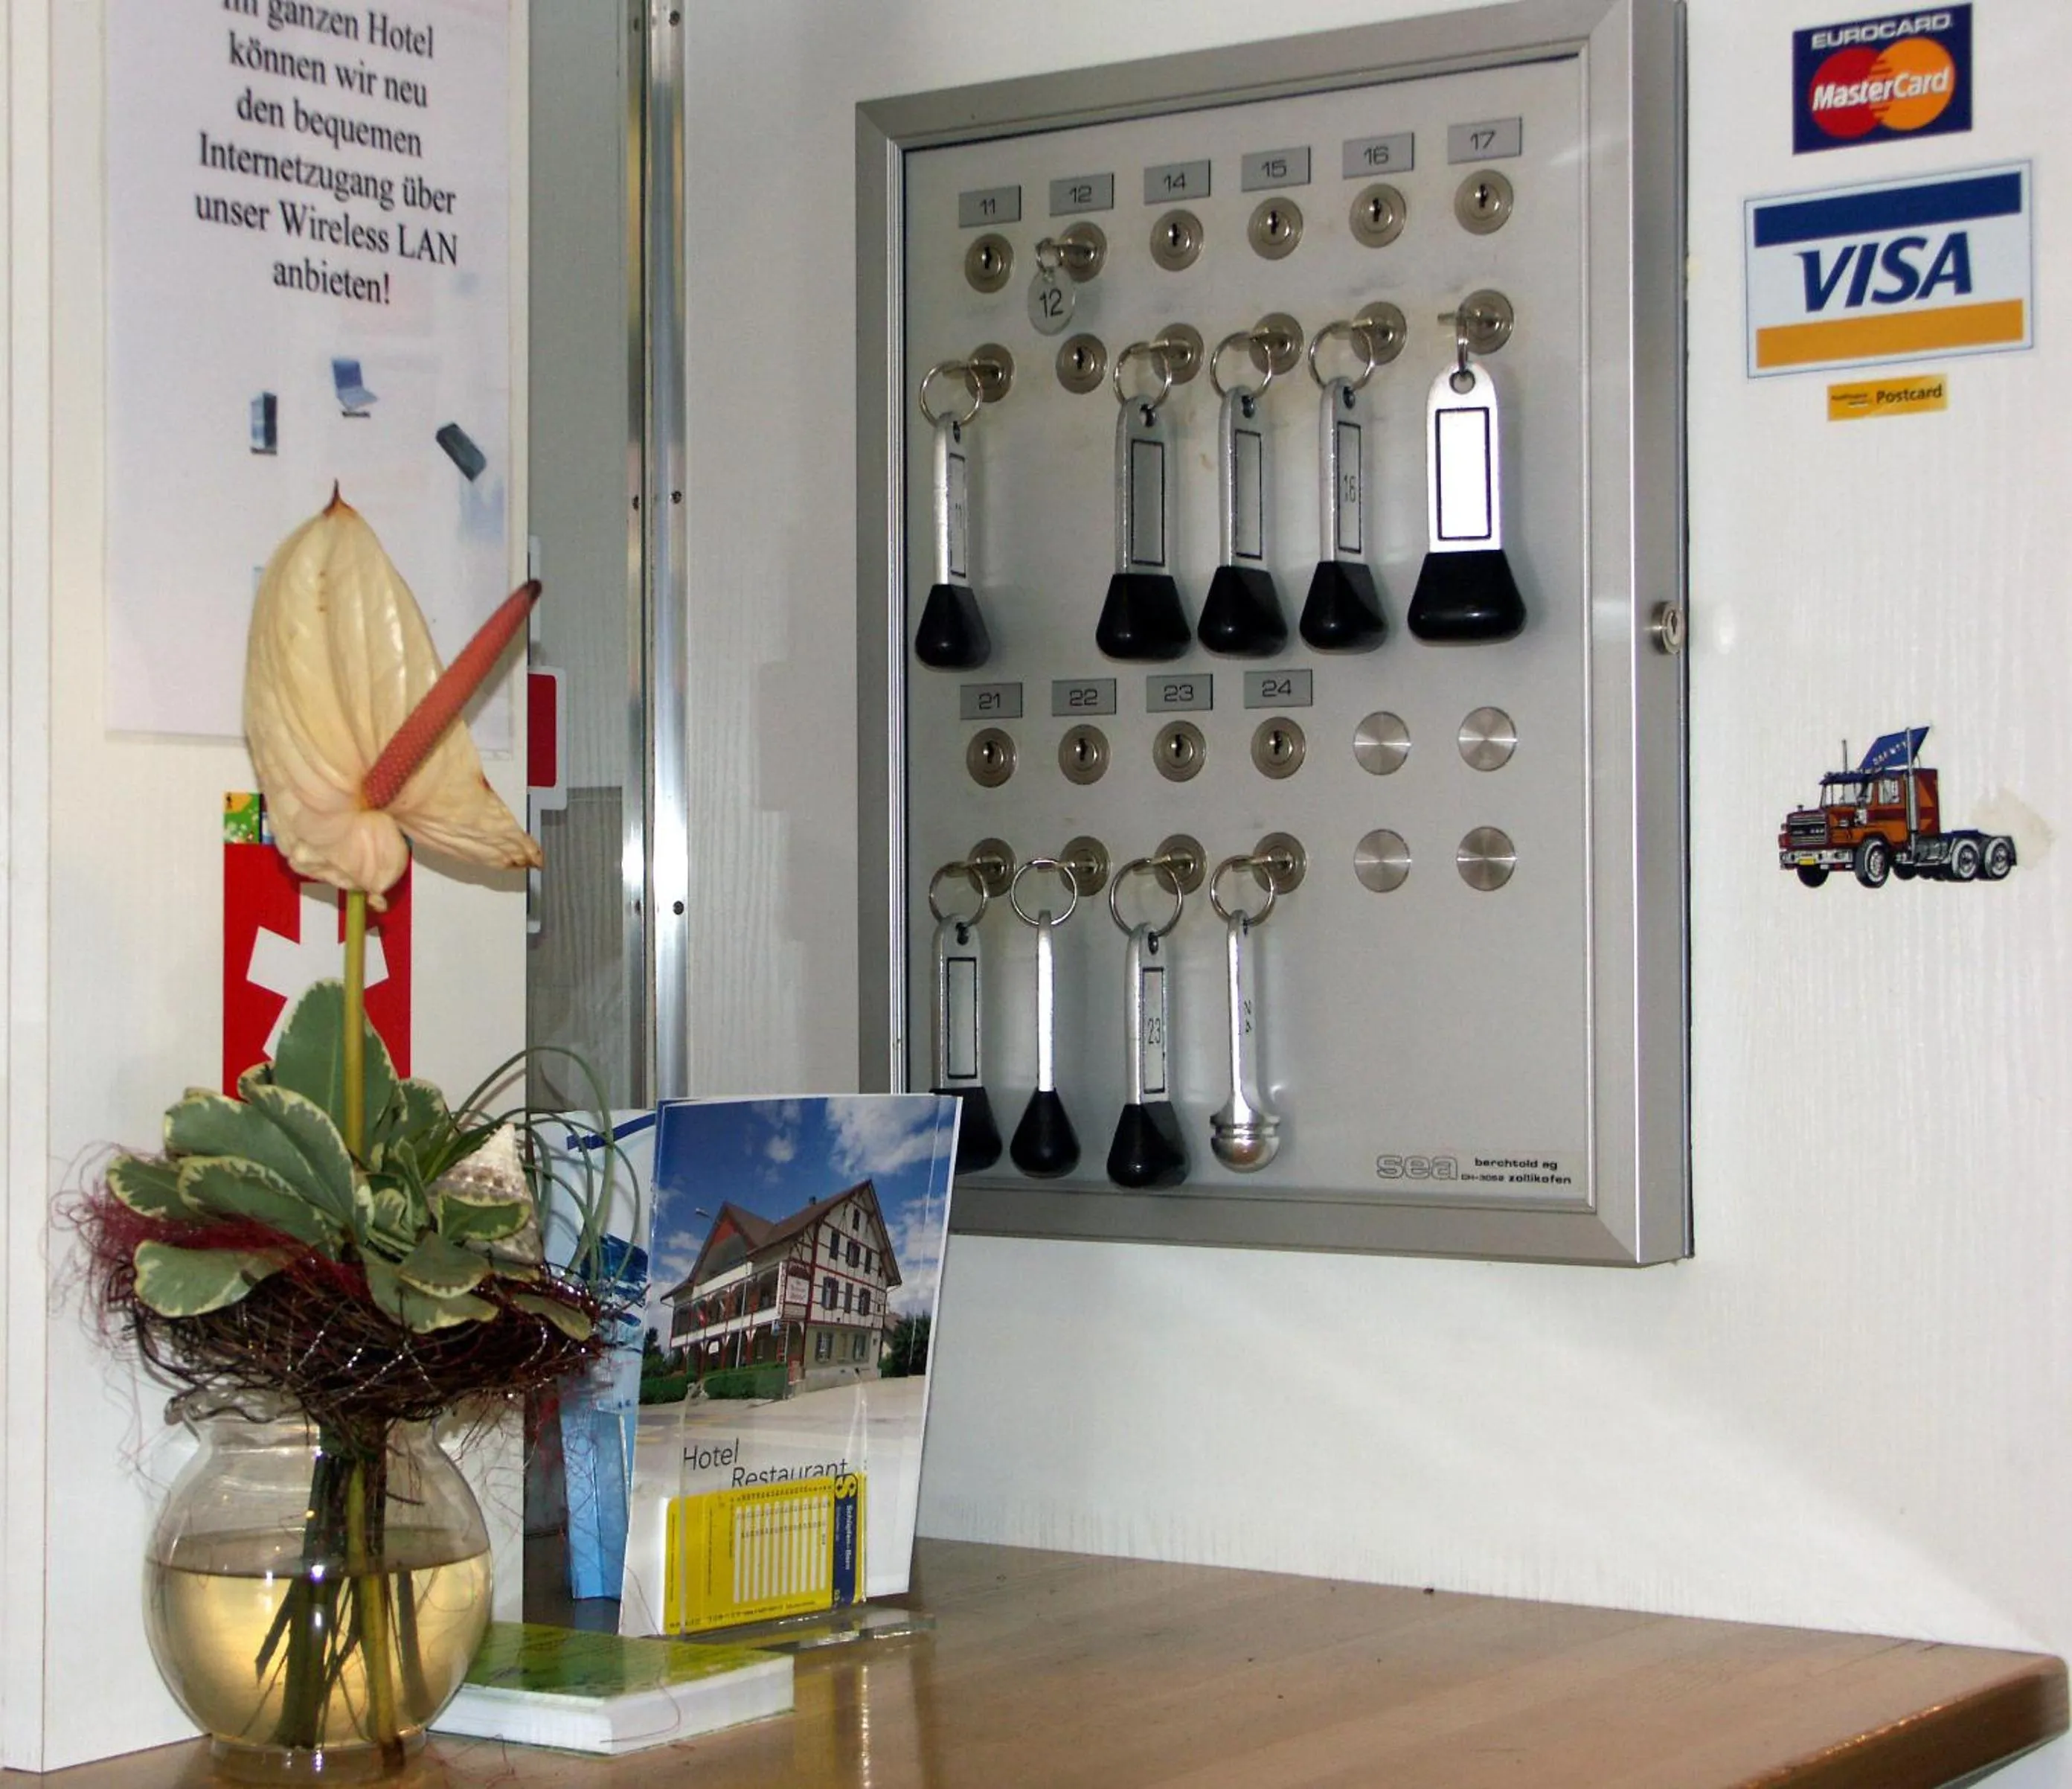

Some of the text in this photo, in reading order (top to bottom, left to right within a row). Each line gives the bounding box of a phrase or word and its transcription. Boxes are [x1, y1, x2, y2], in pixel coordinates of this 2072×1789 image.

[222, 0, 434, 59] m ganzen Hotel
[1811, 13, 1952, 51] EUROCARD
[228, 30, 428, 109] können wir neu
[1812, 65, 1951, 112] MasterCard
[237, 86, 423, 159] den bequemen
[1470, 129, 1496, 150] 17
[1363, 146, 1389, 165] 16
[199, 131, 458, 216] Internetzugang über
[1261, 159, 1287, 178] 15
[1068, 185, 1093, 204] 12
[1163, 173, 1188, 192] 14
[978, 199, 997, 214] 11
[194, 193, 459, 267] unser Wireless LAN
[273, 257, 391, 305] anbieten!
[1792, 231, 1972, 313] VISA
[1039, 288, 1065, 319] 12
[1876, 383, 1943, 404] Postcard
[1069, 688, 1098, 706] 22
[1164, 684, 1194, 703] 23
[1261, 679, 1292, 697] 24
[978, 693, 1001, 710] 21
[1376, 1154, 1458, 1181] sea
[1475, 1157, 1539, 1168] berchtold
[1508, 1174, 1572, 1185] zollikofen
[683, 1437, 740, 1471] Hotel
[731, 1458, 847, 1488] Restaurant
